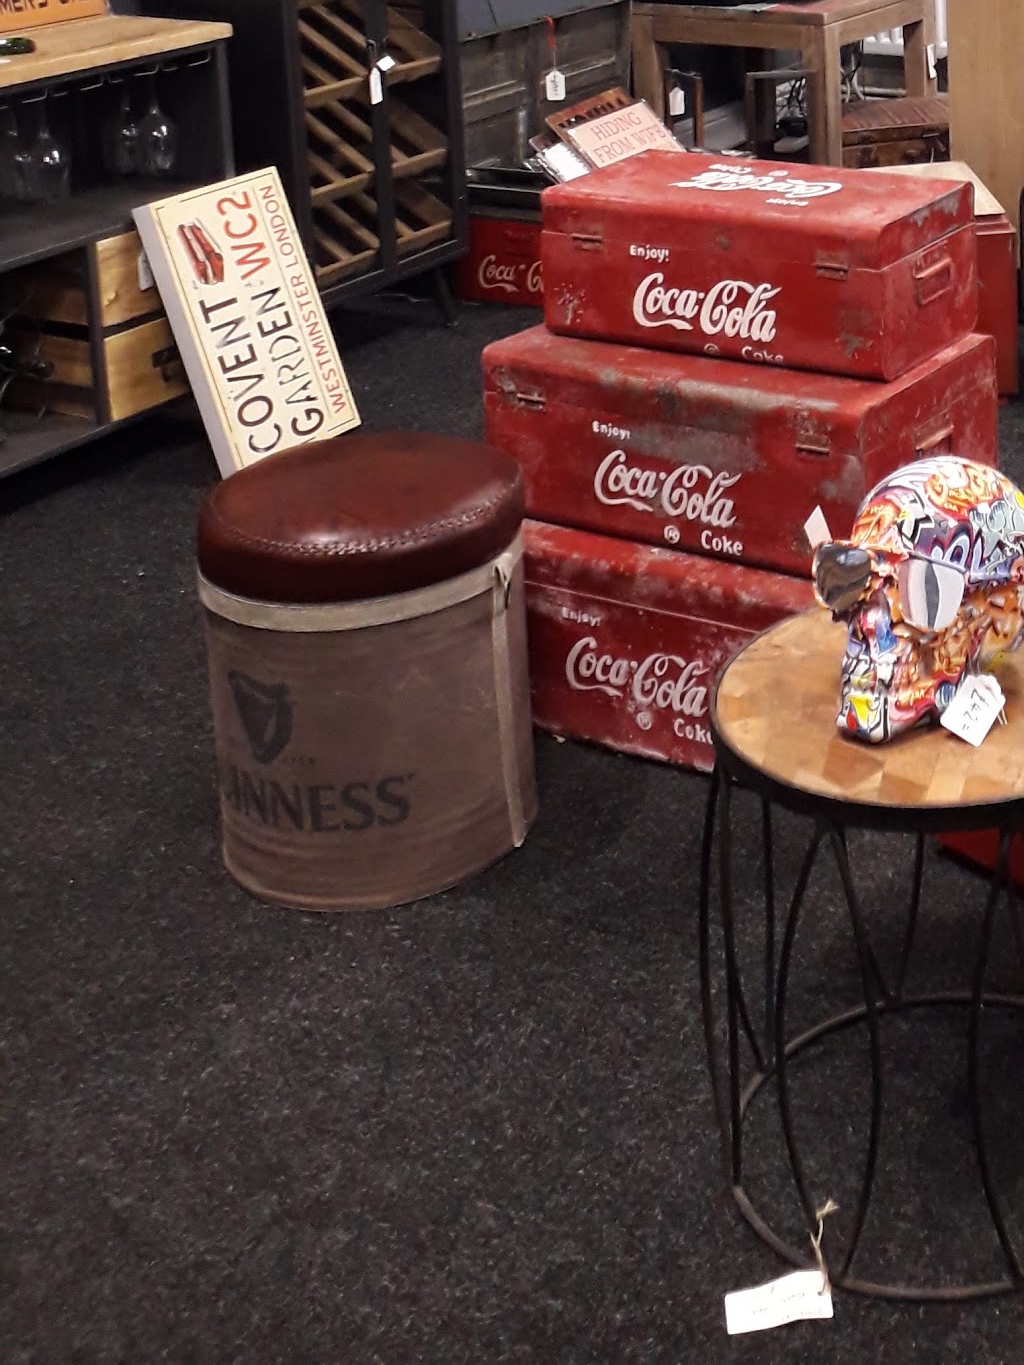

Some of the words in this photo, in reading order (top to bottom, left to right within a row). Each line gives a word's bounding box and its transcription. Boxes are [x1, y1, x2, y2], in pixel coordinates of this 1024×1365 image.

[590, 111, 642, 141] HIDING
[594, 137, 634, 164] FROM
[633, 124, 667, 148] WIFE
[216, 190, 272, 282] WC2
[259, 184, 295, 269] LONDON
[629, 244, 670, 263] Enjoy!
[198, 296, 283, 454] COVENT
[250, 285, 325, 437] GARDEN
[289, 275, 347, 415] WESTMINSTER
[701, 530, 744, 557] Coke
